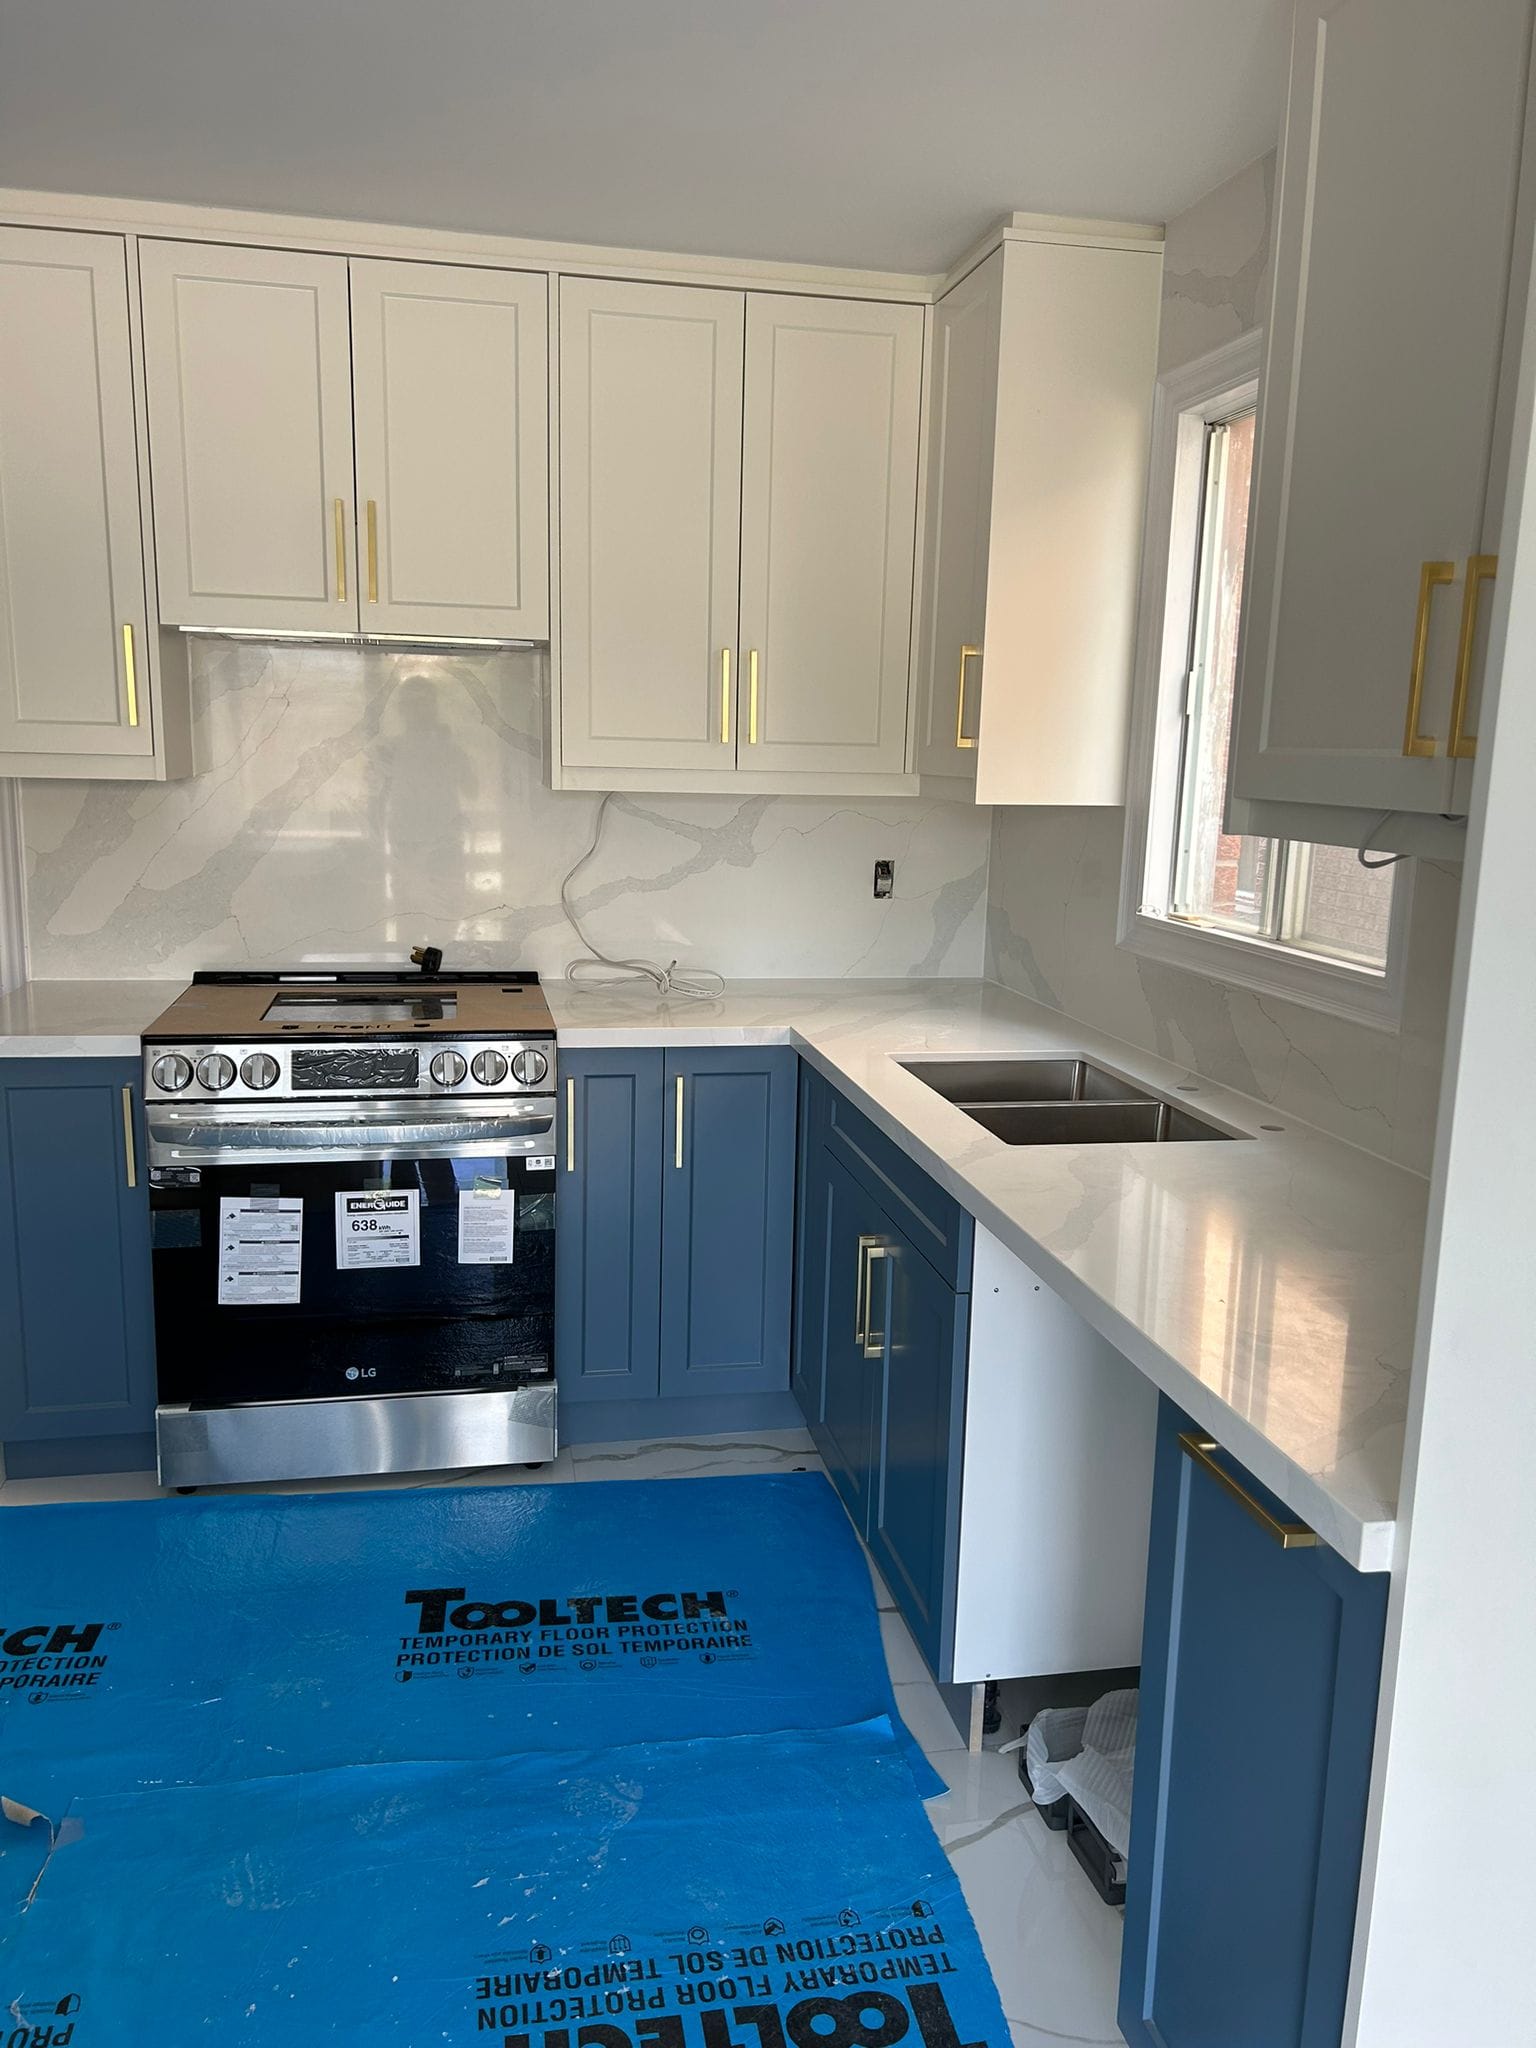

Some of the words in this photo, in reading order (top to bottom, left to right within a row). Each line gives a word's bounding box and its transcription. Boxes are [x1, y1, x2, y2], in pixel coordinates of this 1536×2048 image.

[350, 1199, 406, 1210] ENERGUIDE
[352, 1219, 377, 1231] 638
[361, 1367, 377, 1378] LG
[404, 1587, 728, 1634] TOOLTECH
[0, 1623, 104, 1656] CH
[396, 1646, 530, 1667] PROTECTION
[538, 1644, 565, 1658] DE
[572, 1642, 613, 1657] SOL
[619, 1634, 753, 1654] TEMPORAIRE
[400, 1630, 532, 1650] TEMPORARY
[541, 1627, 610, 1642] FLOOR
[618, 1619, 748, 1637] PROTECTION
[733, 1944, 769, 1969] DE
[774, 1924, 945, 1965] PROTECTION
[476, 1957, 662, 2000] TEMPORAIRE
[668, 1951, 725, 1976] SOL
[783, 1951, 958, 1994] TEMPORARY
[676, 1973, 772, 2006] FLOOR
[478, 1986, 666, 2031] PROTECTION
